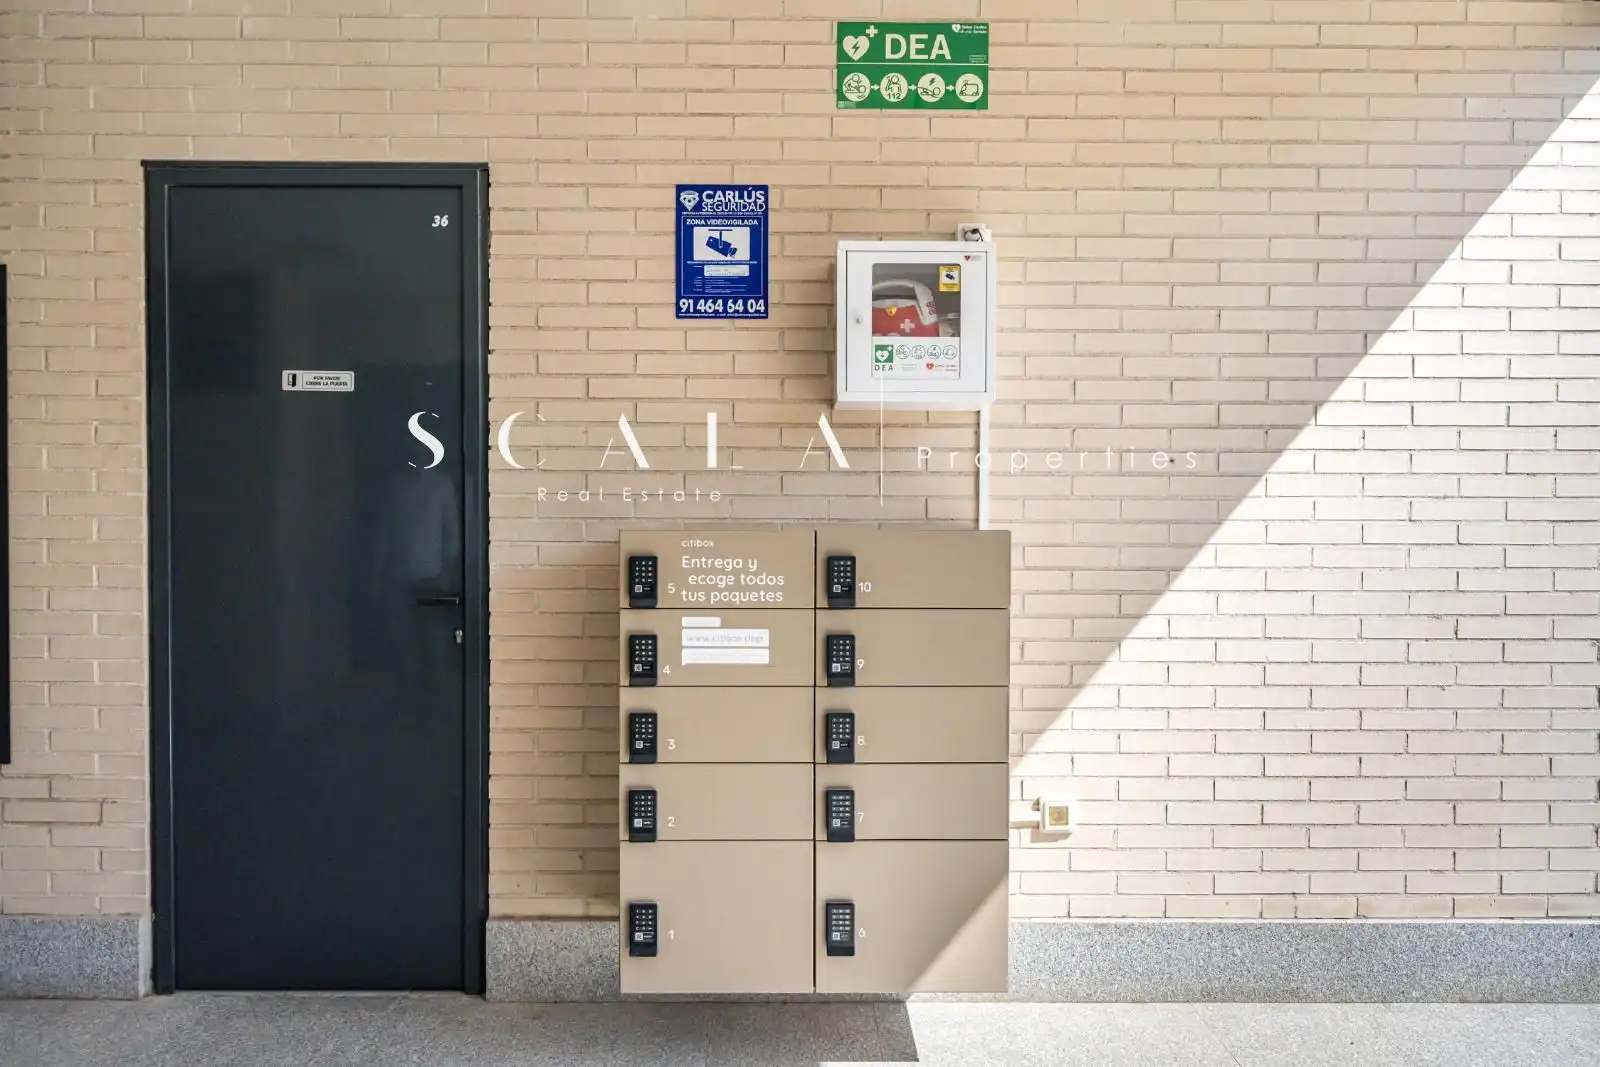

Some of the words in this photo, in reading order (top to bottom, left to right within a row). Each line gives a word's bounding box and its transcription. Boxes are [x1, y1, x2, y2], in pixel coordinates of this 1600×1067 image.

[885, 33, 951, 60] DEA
[887, 92, 901, 100] 112
[702, 187, 765, 202] CARLÚS
[702, 201, 766, 212] SEGURIDAD
[431, 215, 449, 227] 36
[686, 218, 706, 226] ZONA
[707, 218, 758, 226] VIDEOVIGILADA
[680, 299, 694, 313] 91
[697, 299, 723, 313] 464
[727, 299, 744, 313] 64
[747, 299, 765, 313] 04
[874, 364, 894, 372] DEA
[681, 539, 714, 548] citibox
[681, 556, 743, 571] Entrega
[748, 558, 758, 571] y
[740, 573, 785, 586] todos
[667, 583, 676, 594] 5
[858, 581, 872, 593] 10
[681, 589, 706, 602] tus
[710, 590, 784, 605] paquetes
[662, 664, 671, 675] 4
[857, 658, 865, 671] 9
[667, 738, 676, 750] 3
[857, 735, 865, 746] 8
[667, 816, 676, 827] 2
[857, 812, 865, 823] 7
[668, 929, 675, 940] 1
[858, 927, 866, 938] 6
